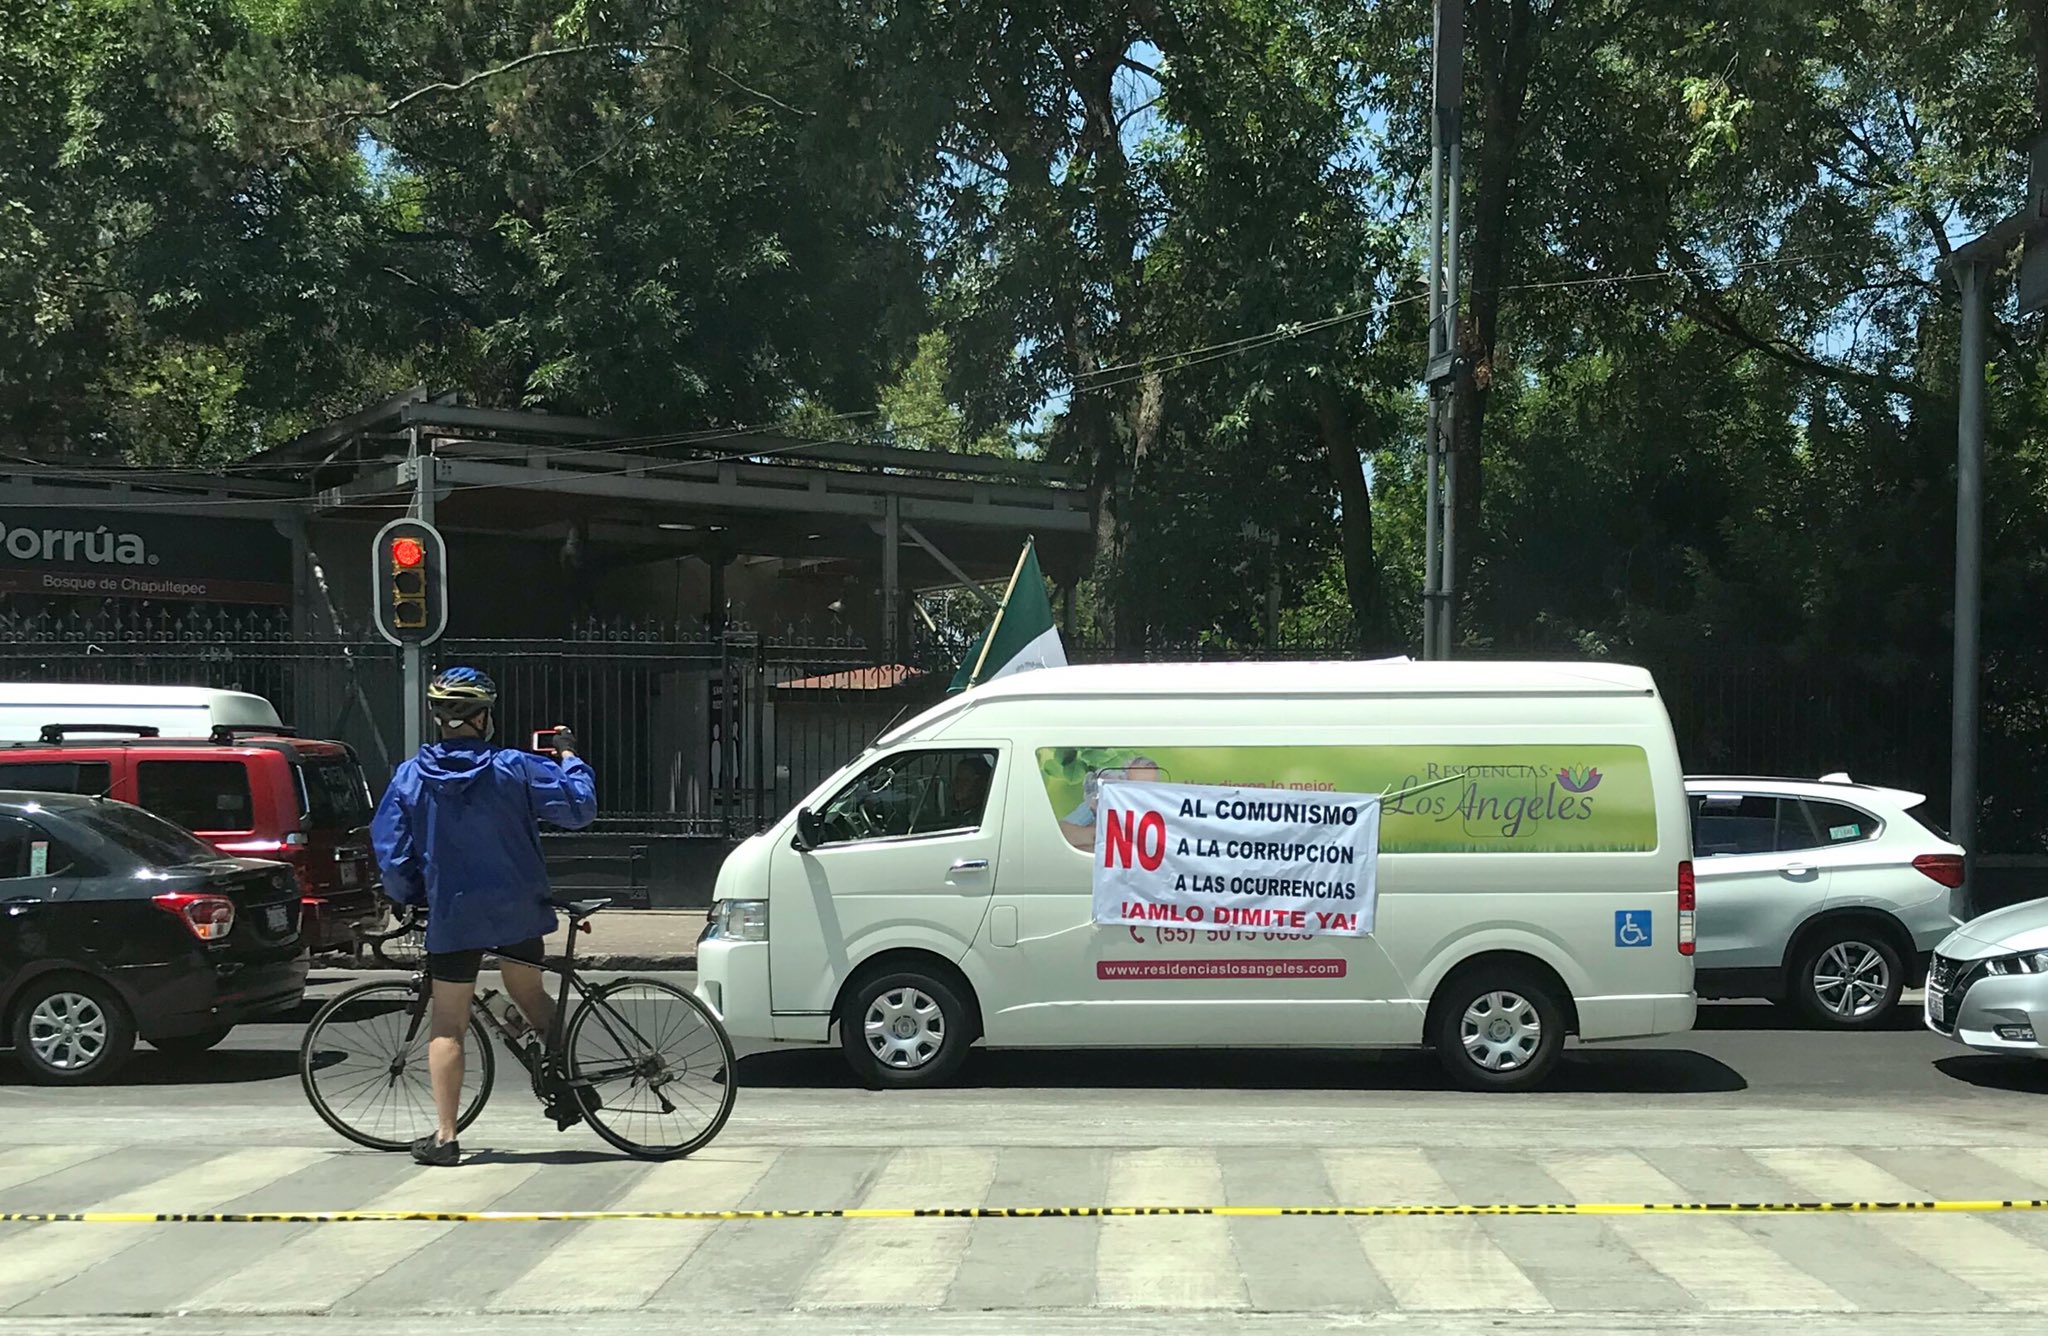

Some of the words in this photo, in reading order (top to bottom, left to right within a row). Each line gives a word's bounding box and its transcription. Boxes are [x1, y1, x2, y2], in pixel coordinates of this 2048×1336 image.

[0, 521, 146, 565] orrúa
[43, 574, 97, 590] Bosque
[100, 577, 117, 590] de
[121, 577, 207, 595] Chapultepec
[1179, 798, 1207, 818] AL
[1215, 800, 1358, 826] COMUNISMO
[1104, 809, 1166, 871] NO
[1177, 838, 1190, 856] A
[1197, 839, 1220, 858] LA
[1227, 840, 1354, 864] CORRUPCIÓN
[1175, 874, 1187, 892] A
[1193, 875, 1225, 894] LAS
[1230, 877, 1356, 900] OCURRENCIAS
[1121, 902, 1205, 923] !AMLO
[1214, 906, 1306, 929] DIMITE
[1316, 911, 1358, 931] YA!
[1104, 962, 1340, 977] www.residenciaslosangeles.com
